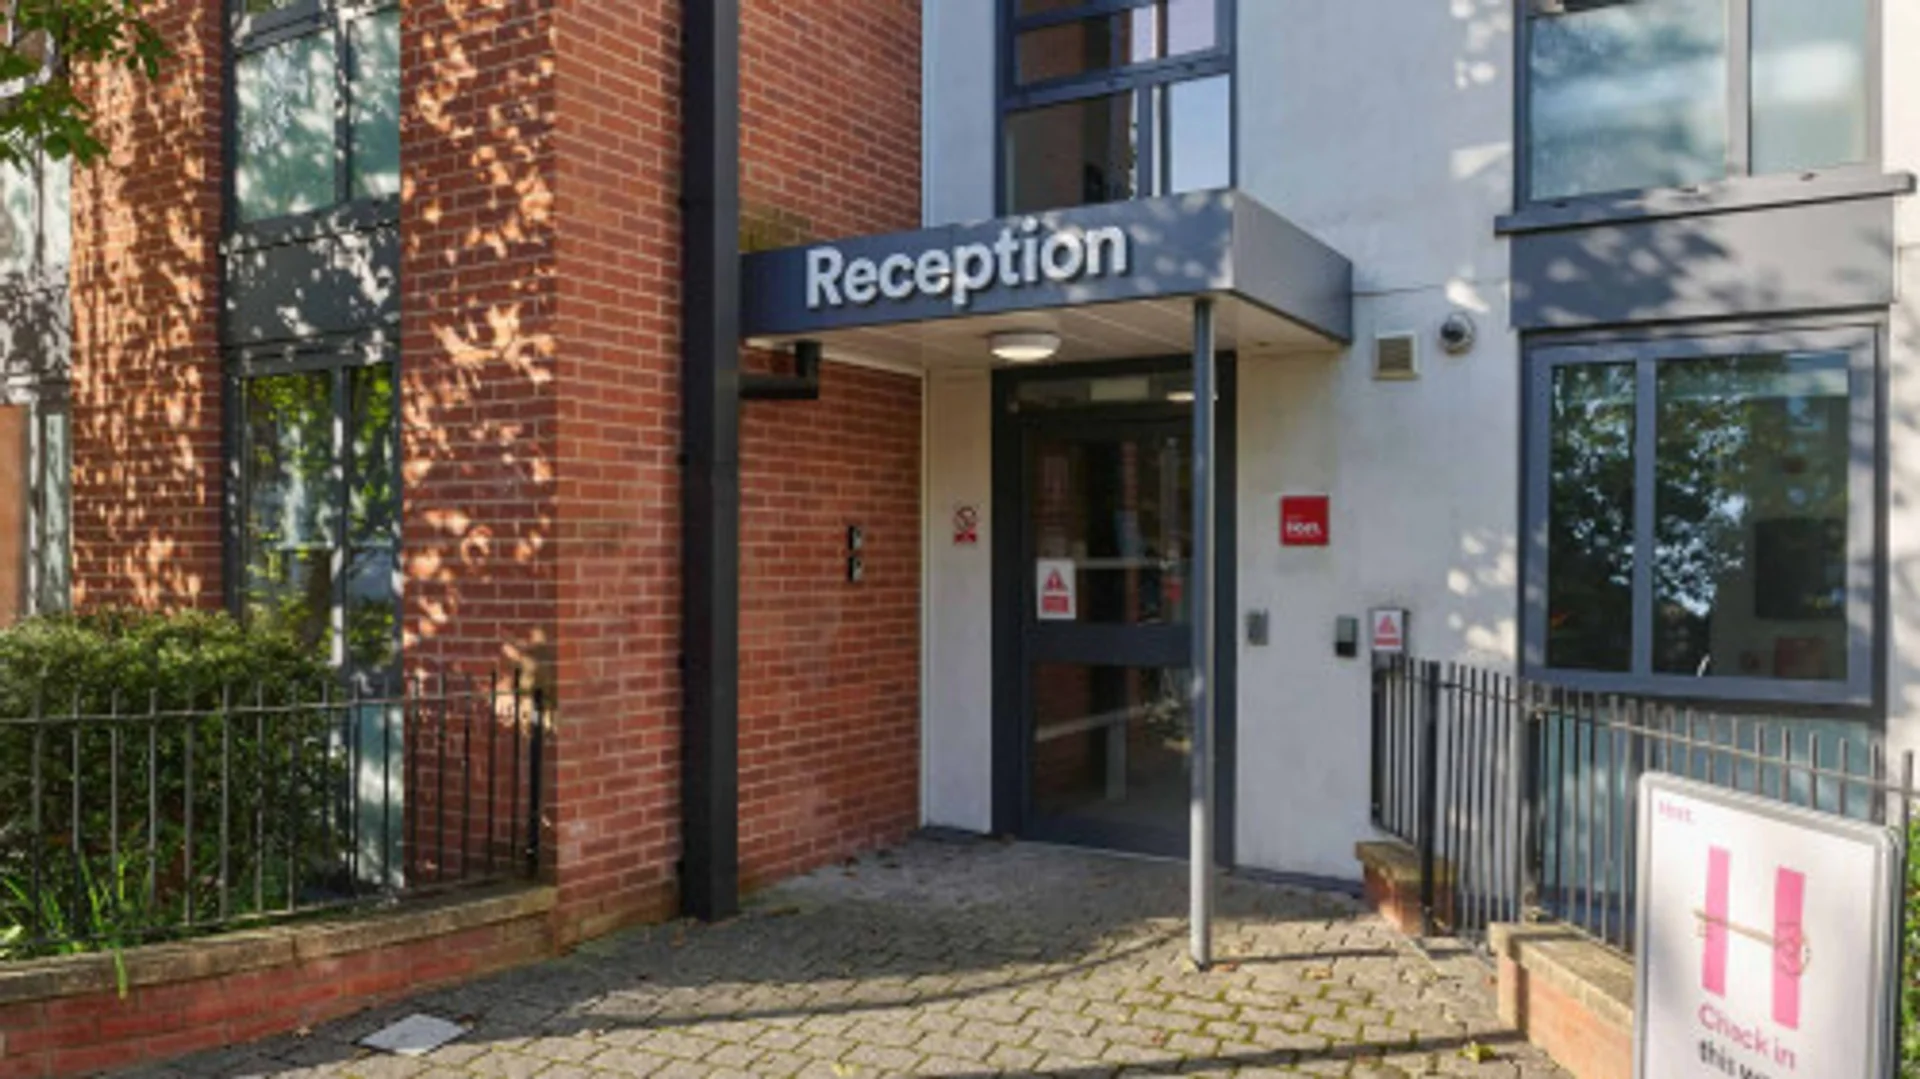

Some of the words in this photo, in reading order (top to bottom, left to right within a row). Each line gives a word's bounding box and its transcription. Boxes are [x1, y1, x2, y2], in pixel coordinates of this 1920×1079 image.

[805, 215, 1127, 308] Reception
[1699, 1003, 1768, 1056] Check
[1774, 1035, 1796, 1072] in
[1699, 1039, 1736, 1077] this
